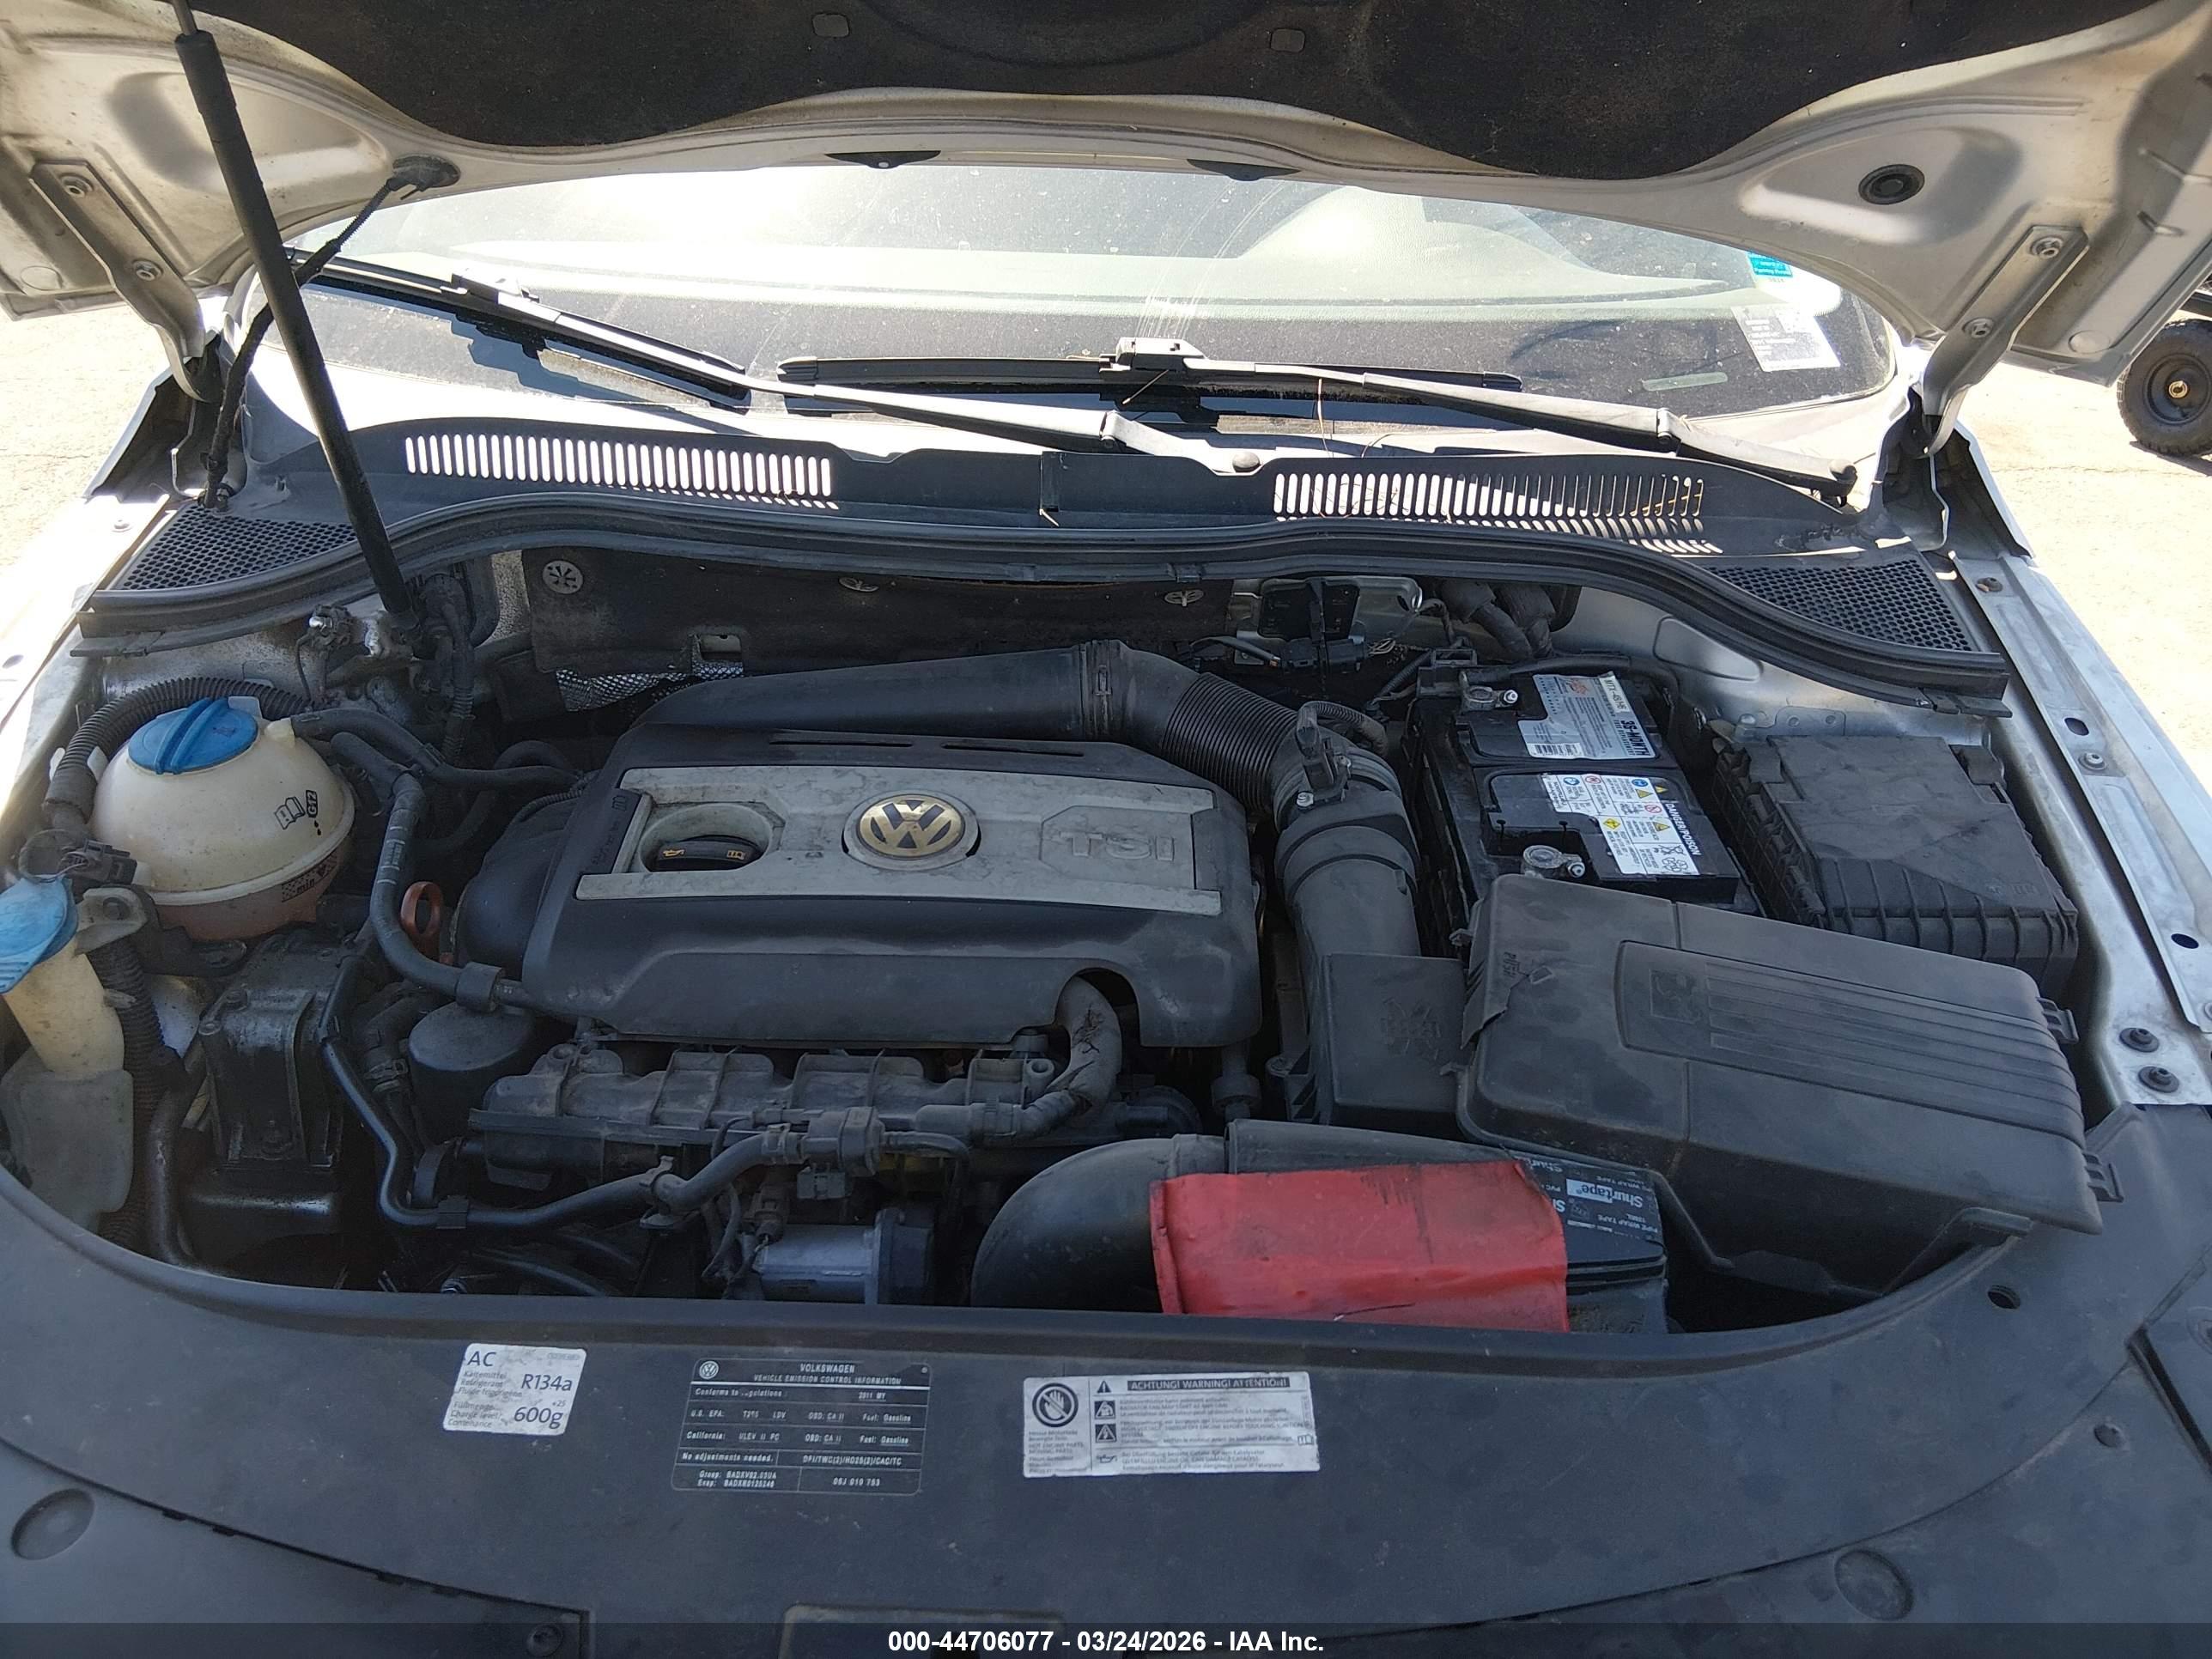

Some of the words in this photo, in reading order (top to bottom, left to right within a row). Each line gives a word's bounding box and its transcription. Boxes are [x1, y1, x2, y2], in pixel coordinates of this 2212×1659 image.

[1620, 720, 1650, 757] 36-MONTH
[1665, 803, 1702, 856] DANGER/POISON
[1059, 830, 1176, 862] TSI
[1598, 1214, 1617, 1224] TAPE
[1618, 1219, 1641, 1230] WRAP
[467, 1351, 496, 1367] AC
[799, 1363, 855, 1374] VOLKSWAGEN
[520, 1373, 573, 1392] R134a
[754, 1374, 783, 1382] VEHICLE
[784, 1374, 818, 1383] EMISSION
[820, 1376, 852, 1384] CONTROL
[854, 1376, 902, 1385] INFORMATION
[1131, 1379, 1181, 1390] ACHTUNG!
[1182, 1378, 1231, 1389] WARNING!
[695, 1388, 729, 1396] Conforms
[858, 1391, 873, 1400] 2011
[514, 1406, 564, 1430] 600g
[690, 1409, 704, 1418] U.S.
[772, 1410, 787, 1419] LDV
[883, 1413, 911, 1423] Gasoline
[686, 1431, 726, 1440] California:
[805, 1433, 822, 1443] OBD:
[859, 1435, 877, 1444] Fuel:
[880, 1436, 909, 1444] Gasoline
[682, 1452, 693, 1461] No
[694, 1452, 741, 1462] adjustments
[743, 1454, 774, 1462] needed.
[699, 1469, 722, 1480] Group:
[696, 1478, 717, 1488] Evap:
